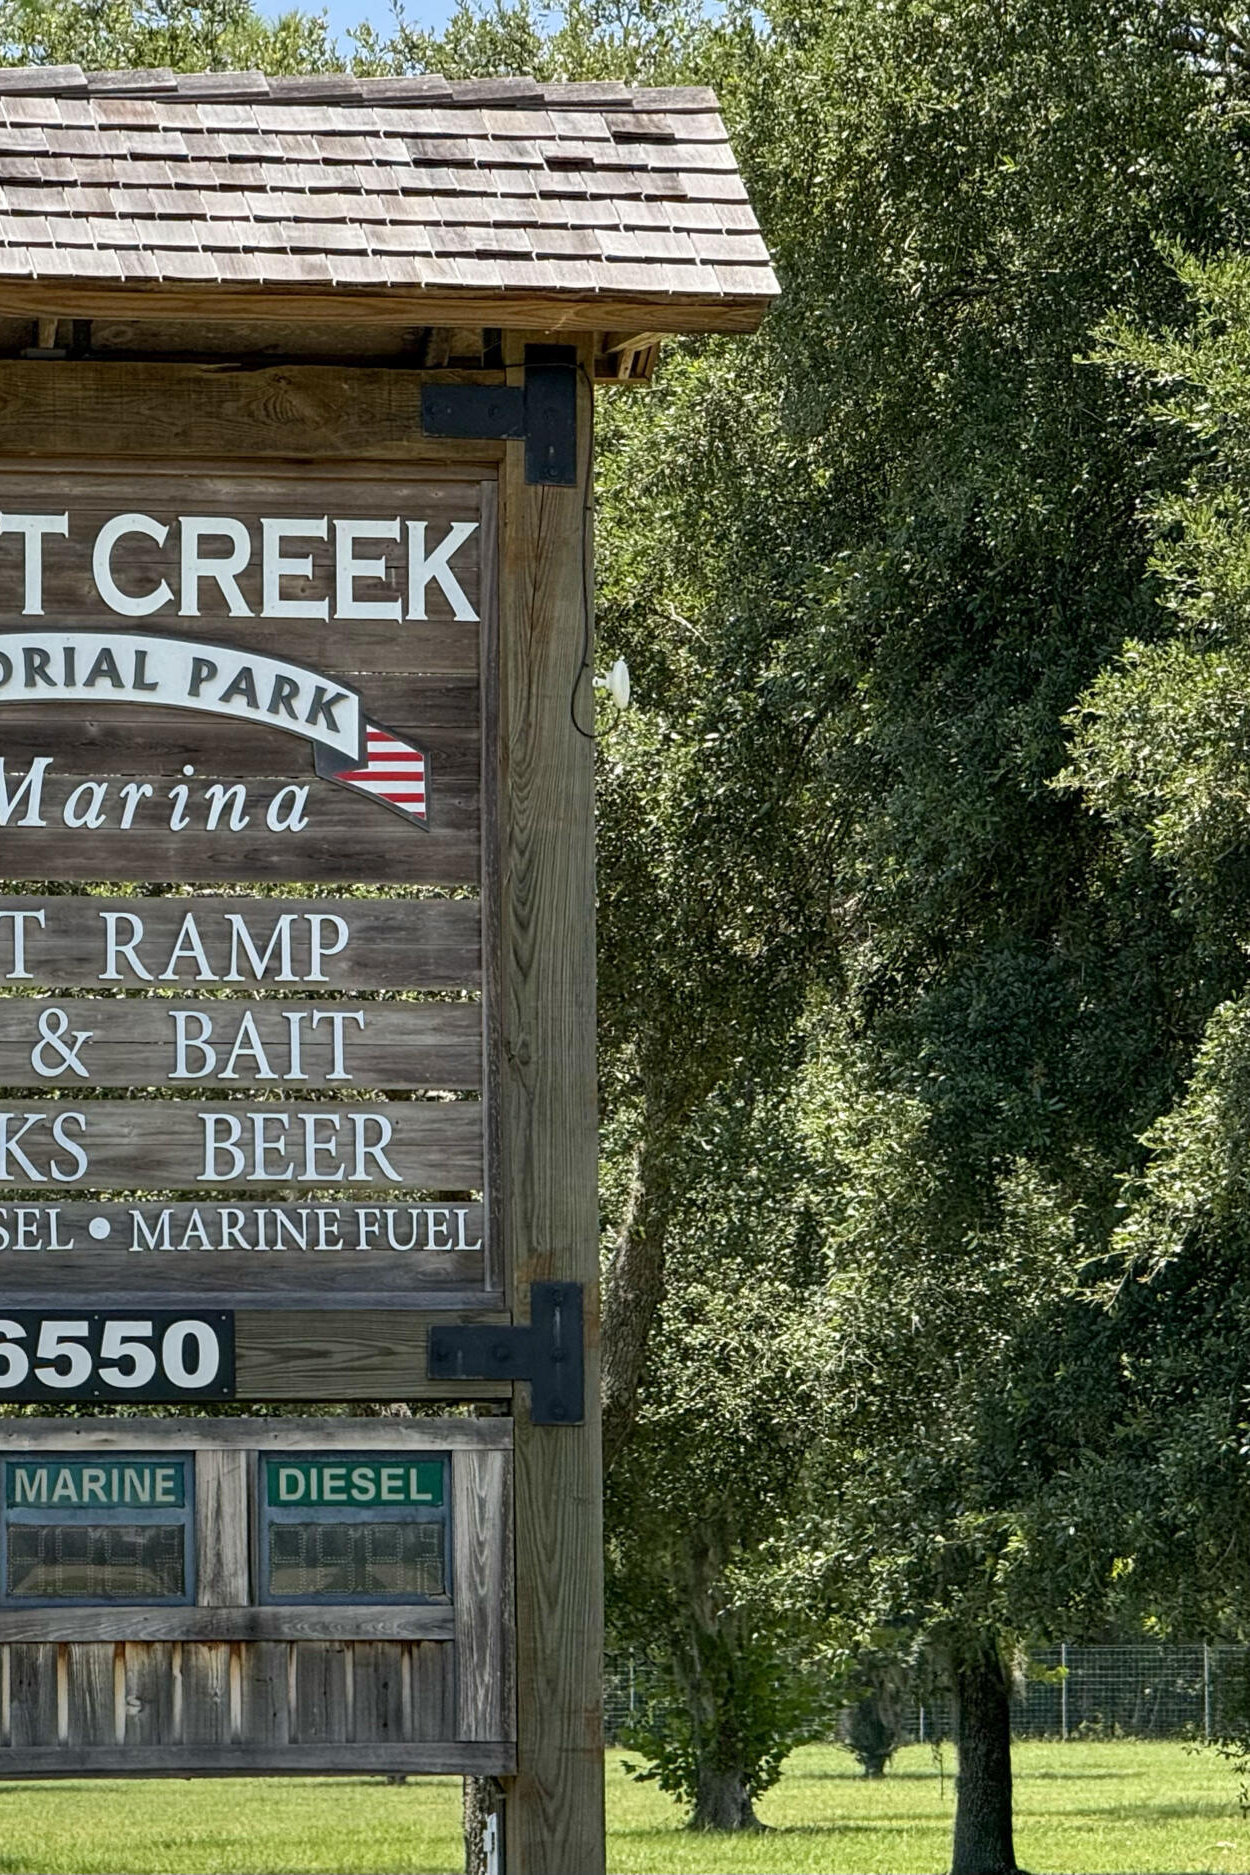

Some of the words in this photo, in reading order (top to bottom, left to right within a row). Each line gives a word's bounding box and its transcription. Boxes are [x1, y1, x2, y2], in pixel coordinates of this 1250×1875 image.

[91, 512, 480, 623] CREEK
[187, 655, 350, 734] PARK
[98, 911, 351, 984] RAMP
[30, 1007, 94, 1079] &
[168, 1009, 365, 1081] BAIT
[196, 1111, 403, 1183] BEER
[128, 1207, 344, 1252] MARINE
[352, 1208, 483, 1252] FUEL
[12, 1466, 177, 1504] MARINE
[277, 1466, 434, 1502] DIESEL
